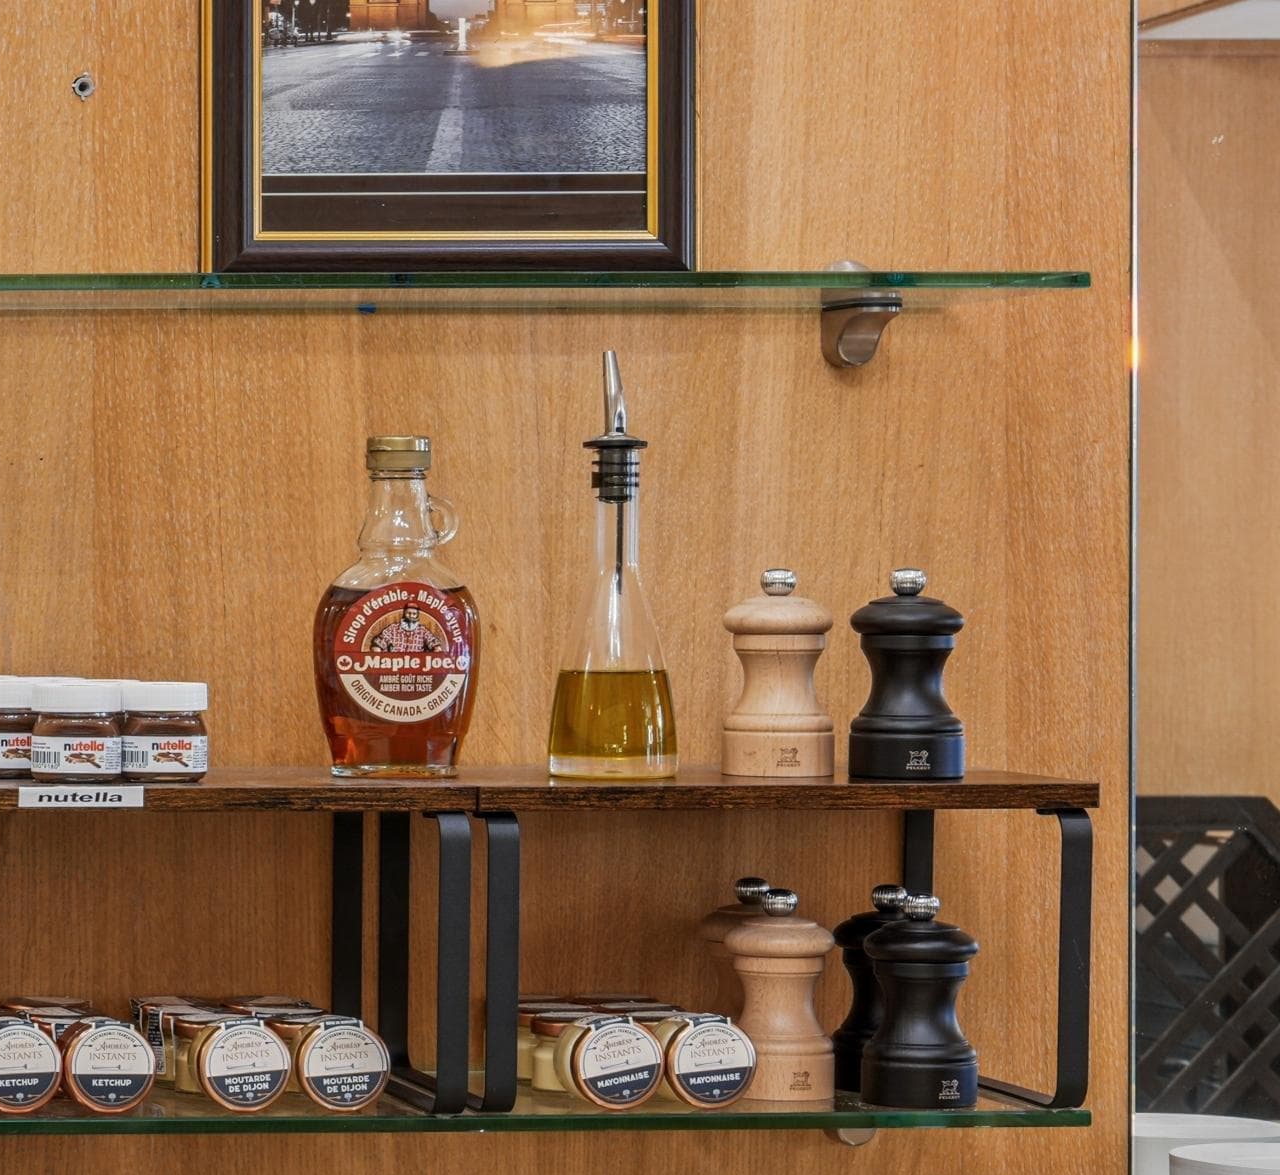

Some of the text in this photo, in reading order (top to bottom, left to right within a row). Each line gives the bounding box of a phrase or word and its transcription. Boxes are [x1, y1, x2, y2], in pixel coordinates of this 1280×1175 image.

[343, 613, 366, 644] Sirop
[363, 589, 408, 616] d'érable
[417, 590, 447, 613] Maple
[445, 612, 463, 643] syrup
[354, 655, 420, 672] Maple
[380, 684, 400, 692] AMBER
[416, 684, 432, 692] TASTE
[351, 680, 383, 710] ORIGINE
[384, 703, 422, 716] CANADA
[427, 687, 453, 711] GRADE
[64, 740, 104, 751] nutella
[152, 740, 192, 751] nutella
[38, 792, 123, 803] nutella
[223, 1051, 270, 1061] INSTANTS
[321, 1051, 368, 1061] INSTANTS
[595, 1047, 642, 1062] INSTANTS
[690, 1047, 736, 1058] INSTANTS
[0, 1078, 39, 1087] KETCHUP
[92, 1079, 132, 1087] KETCHUP
[225, 1074, 271, 1085] MOUTARDE
[323, 1075, 369, 1085] MOUTARDE
[597, 1071, 649, 1088] MAYONNAISE
[690, 1073, 740, 1085] MAYONNAISE
[243, 1083, 269, 1091] DIJON
[341, 1084, 367, 1092] DIJON
